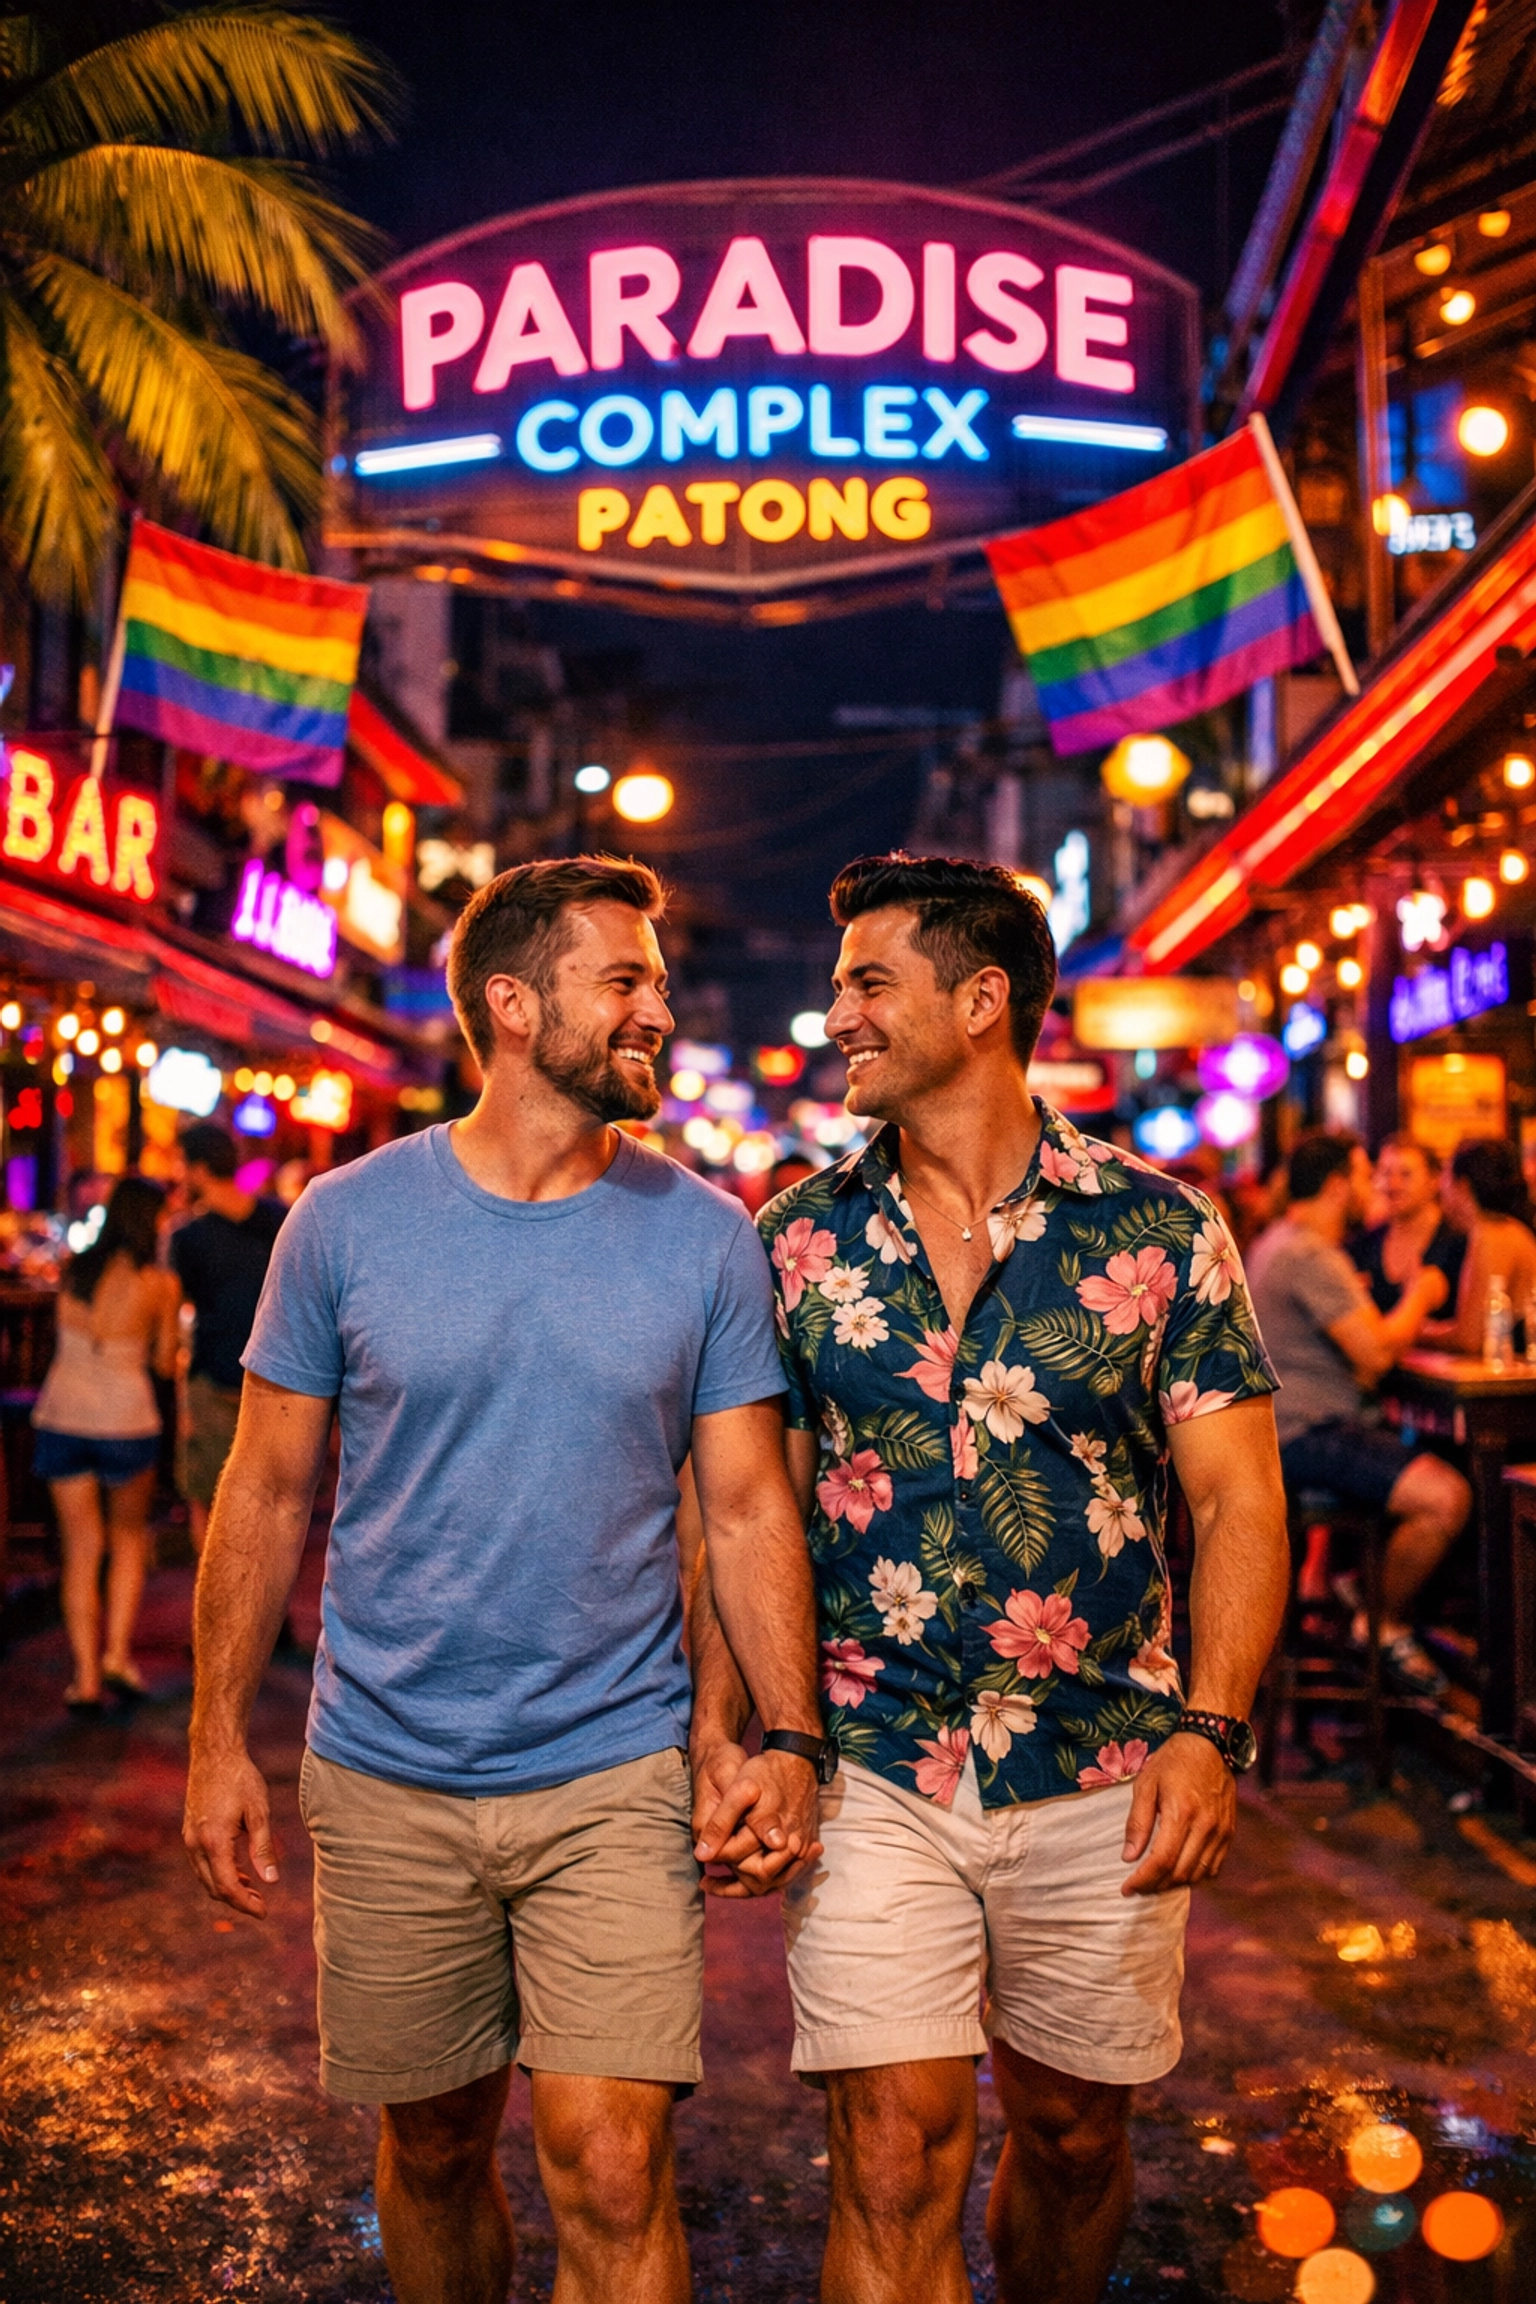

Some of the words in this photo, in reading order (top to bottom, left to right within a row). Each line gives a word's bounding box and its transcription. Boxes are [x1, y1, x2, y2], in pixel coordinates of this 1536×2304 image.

[401, 236, 1134, 410] PARADISE
[516, 383, 989, 472] COMPLEX
[578, 477, 930, 550] PATONG
[3, 750, 157, 899] BAR
